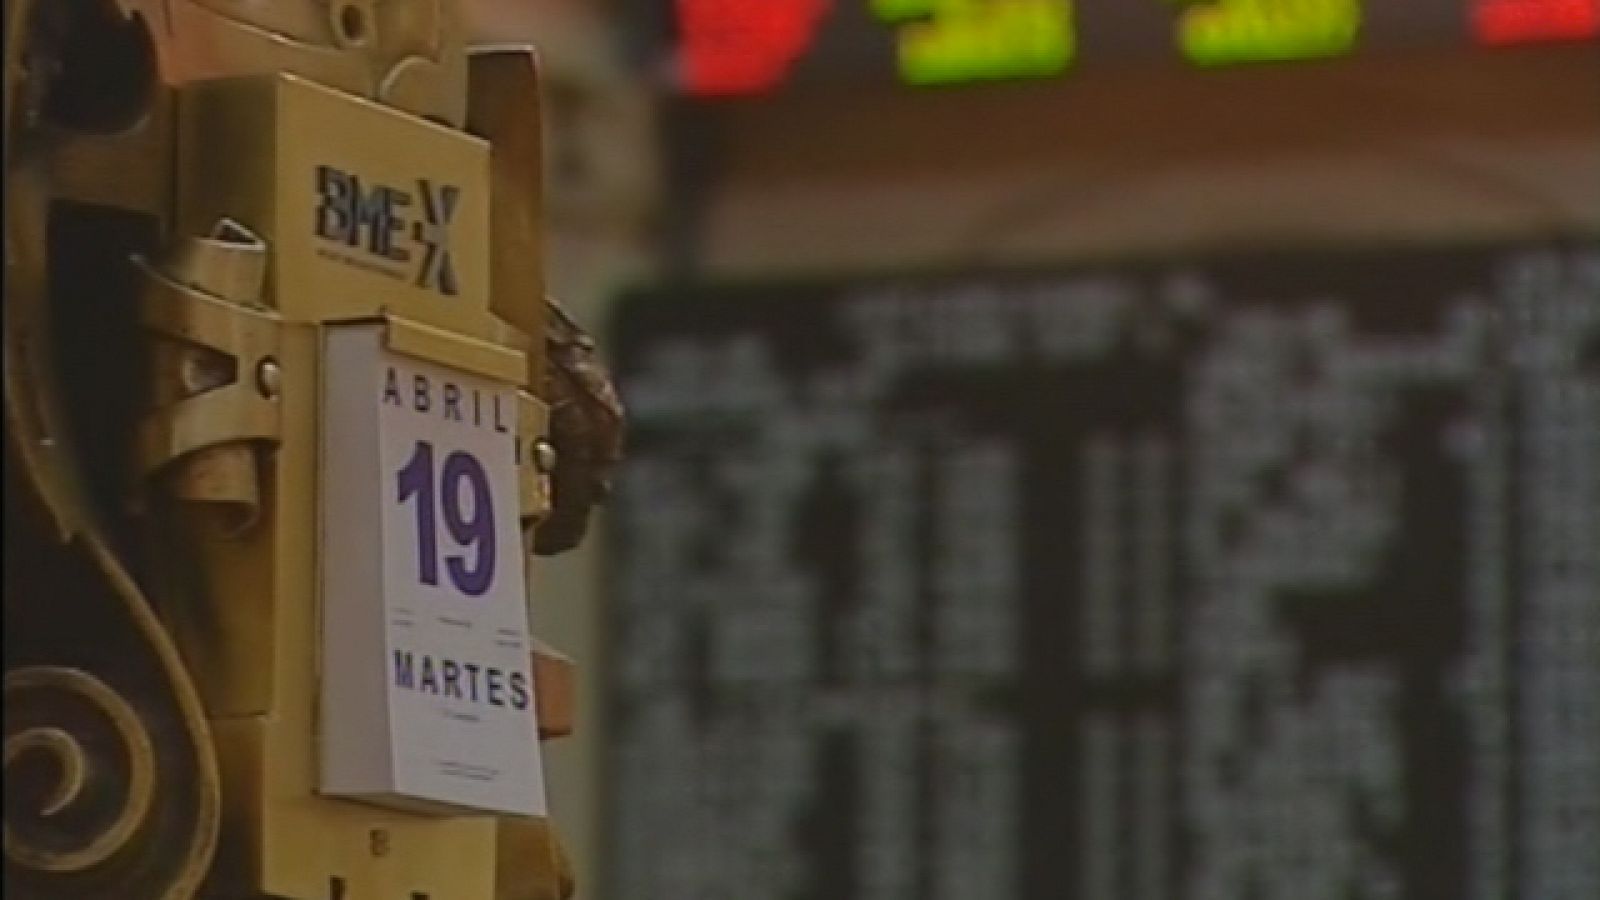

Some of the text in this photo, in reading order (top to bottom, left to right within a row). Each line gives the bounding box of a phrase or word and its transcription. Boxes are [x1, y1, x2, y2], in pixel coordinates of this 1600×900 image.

[384, 366, 508, 432] ABRIL
[397, 440, 495, 595] 19
[394, 649, 528, 710] MARTES
